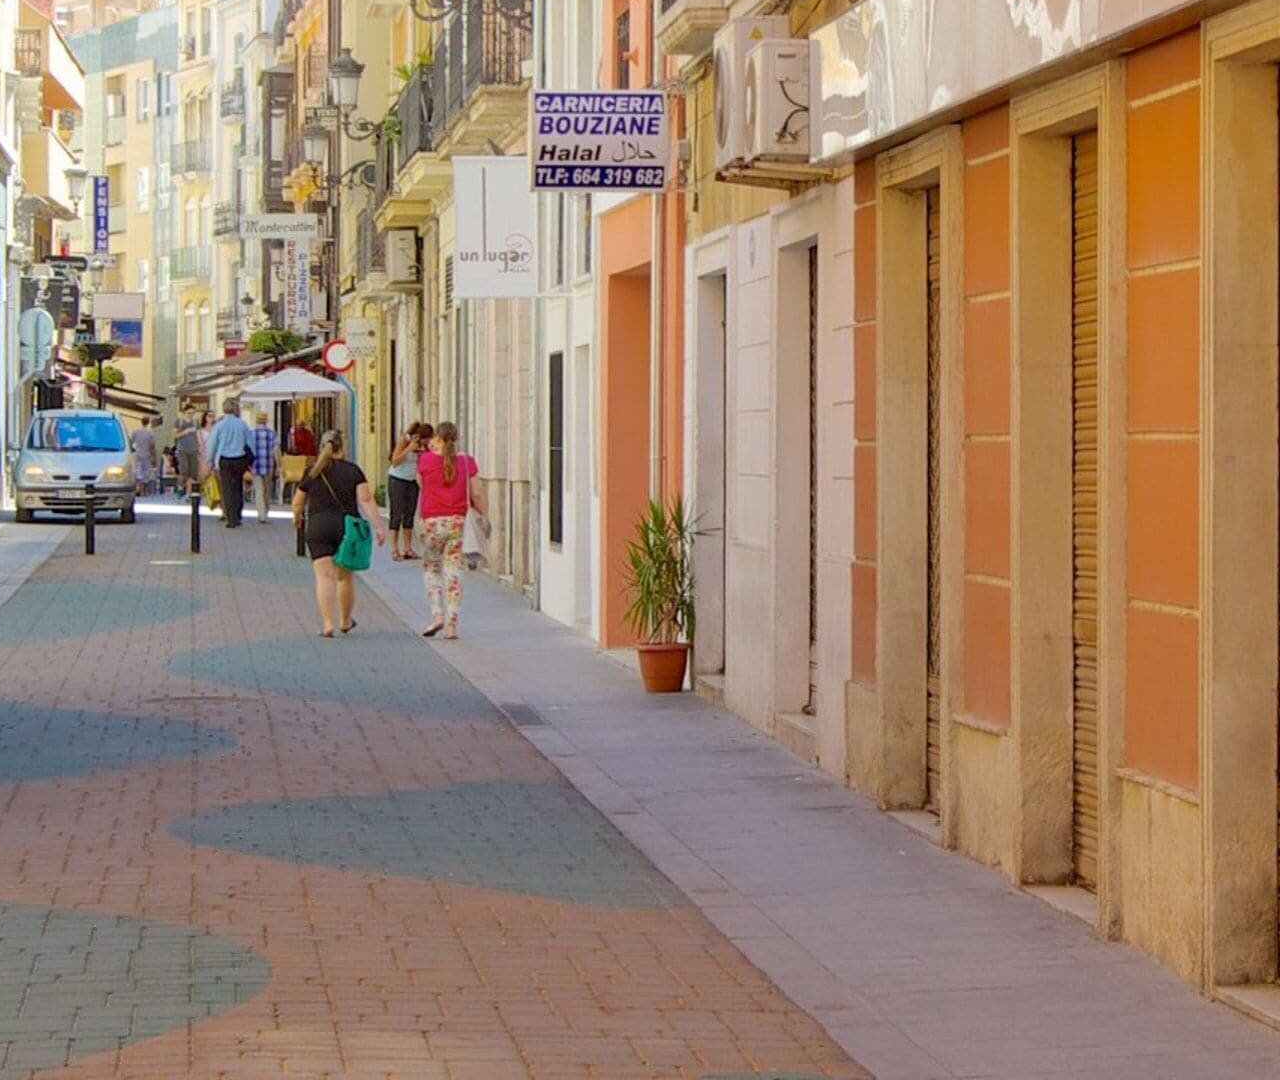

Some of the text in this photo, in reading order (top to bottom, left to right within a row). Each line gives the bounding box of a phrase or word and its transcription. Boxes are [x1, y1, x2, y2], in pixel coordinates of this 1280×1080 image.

[535, 95, 664, 113] CARNICERIA
[538, 116, 661, 135] BOUZIANE
[538, 144, 602, 161] Halal
[611, 140, 656, 163] حلال
[536, 167, 664, 185] TLF: 664 319 682
[97, 178, 107, 249] PENSION
[460, 252, 479, 262] un
